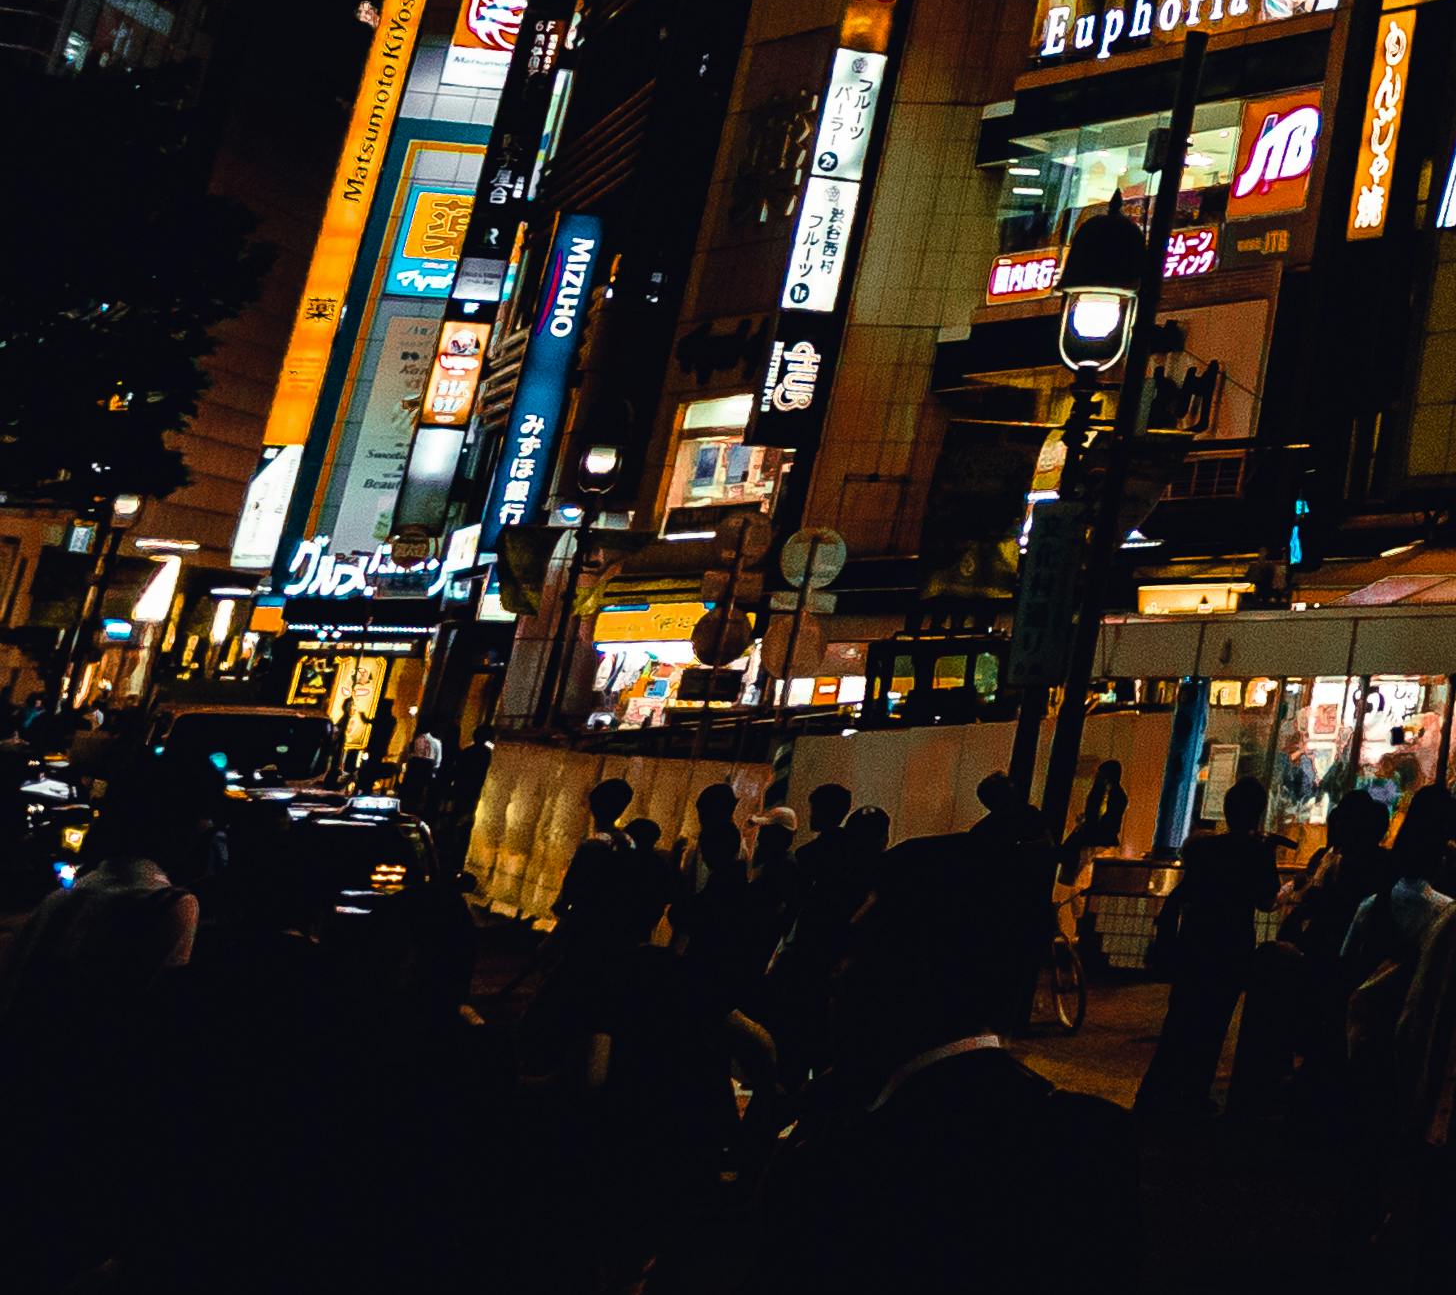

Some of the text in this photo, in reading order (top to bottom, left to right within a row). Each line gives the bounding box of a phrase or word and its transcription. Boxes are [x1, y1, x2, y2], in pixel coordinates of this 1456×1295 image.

[849, 78, 874, 141] フルーツ
[1233, 106, 1323, 200] JTB
[548, 236, 595, 339] MIZUHO
[498, 413, 546, 526] みずほ銀行
